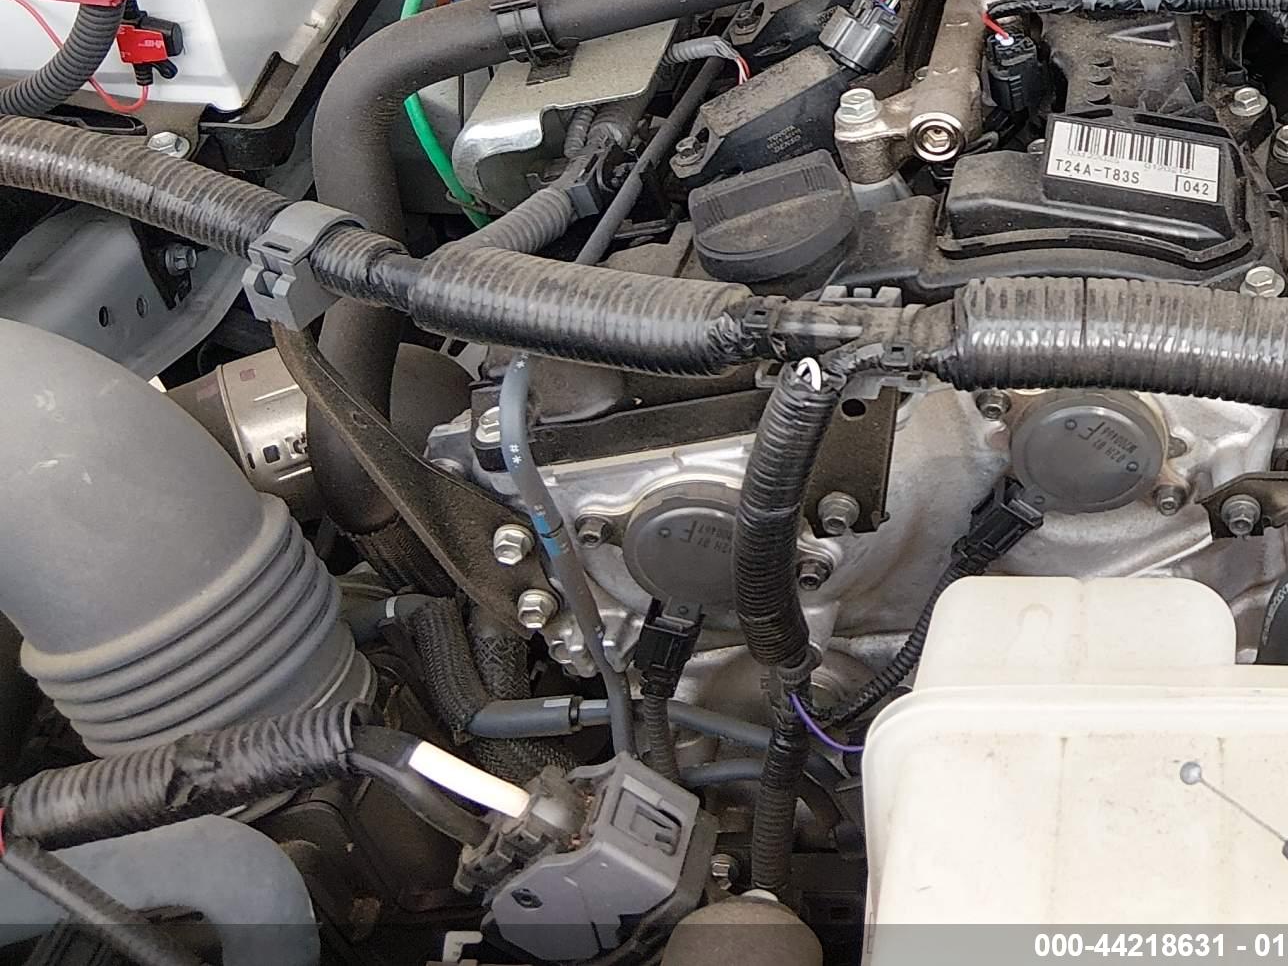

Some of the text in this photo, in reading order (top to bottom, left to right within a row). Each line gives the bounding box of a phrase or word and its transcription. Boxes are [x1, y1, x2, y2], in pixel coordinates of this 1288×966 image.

[773, 135, 801, 153] DENSO
[1056, 158, 1141, 185] T24A-T83S
[1183, 180, 1210, 197] 042
